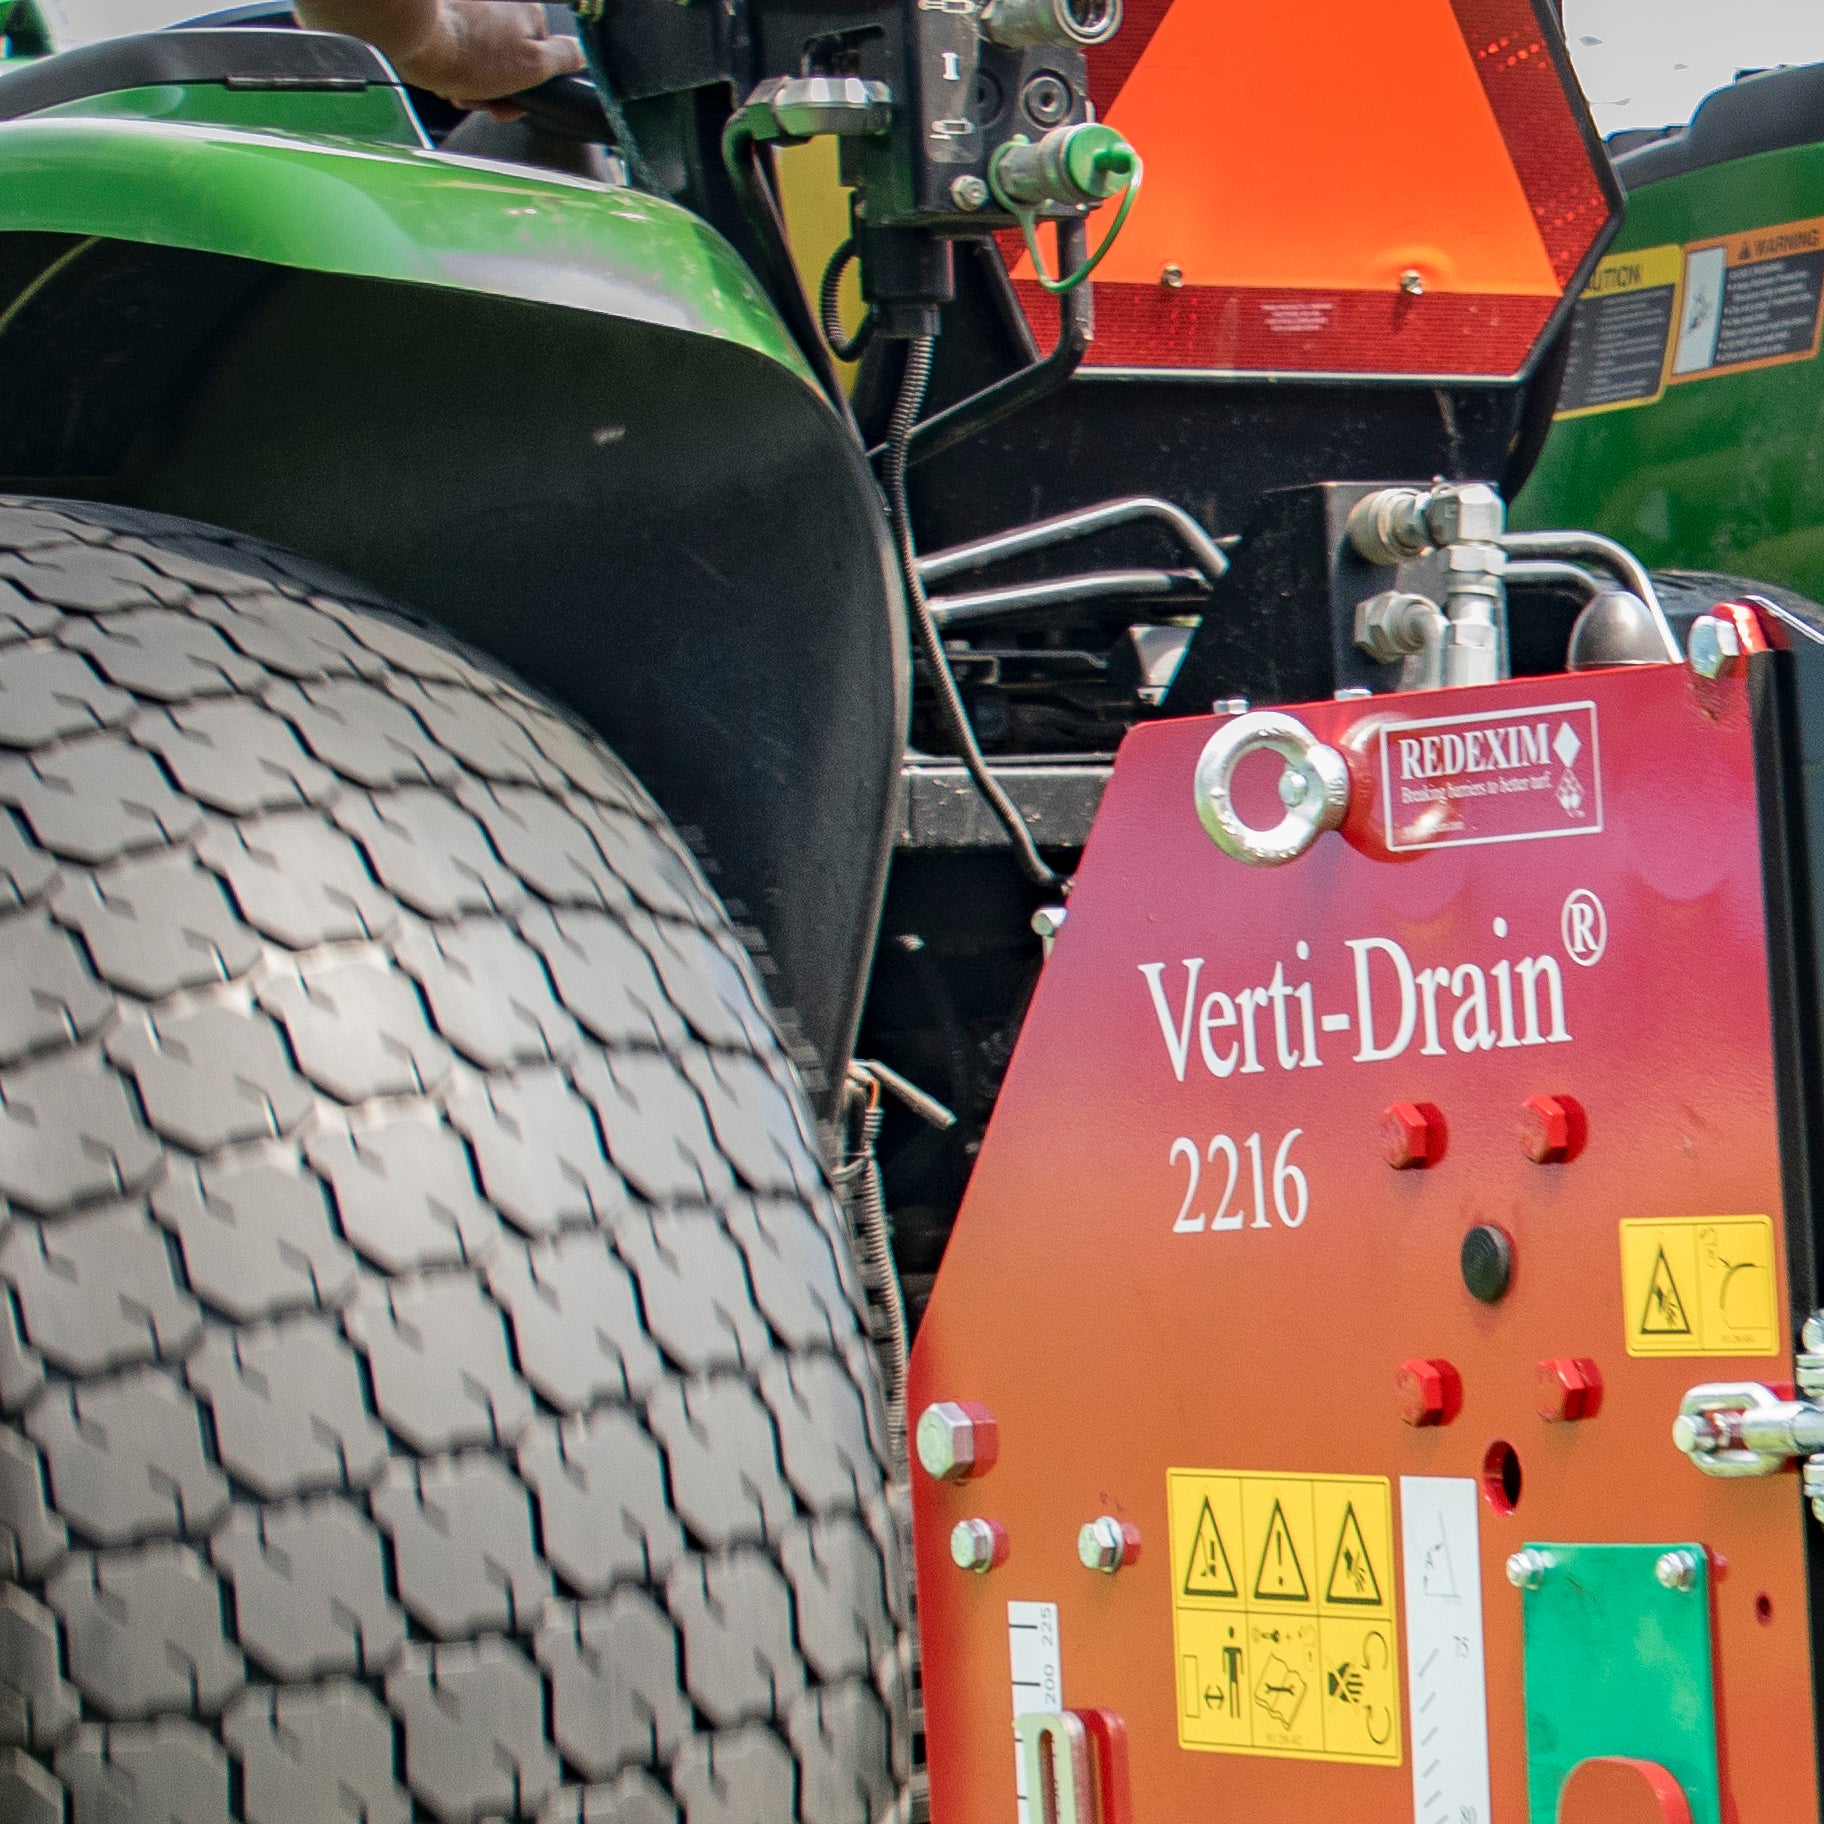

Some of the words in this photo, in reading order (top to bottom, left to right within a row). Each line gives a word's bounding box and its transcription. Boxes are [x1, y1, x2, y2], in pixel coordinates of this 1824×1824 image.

[1755, 228, 1819, 256] WARNING
[1398, 722, 1552, 781] REDEXIM
[1401, 785, 1447, 805] Breaking
[1487, 781, 1498, 794] to
[1500, 777, 1529, 794] better
[1169, 1128, 1309, 1234] 2216
[1040, 1607, 1053, 1647] 225
[1043, 1664, 1056, 1705] 200
